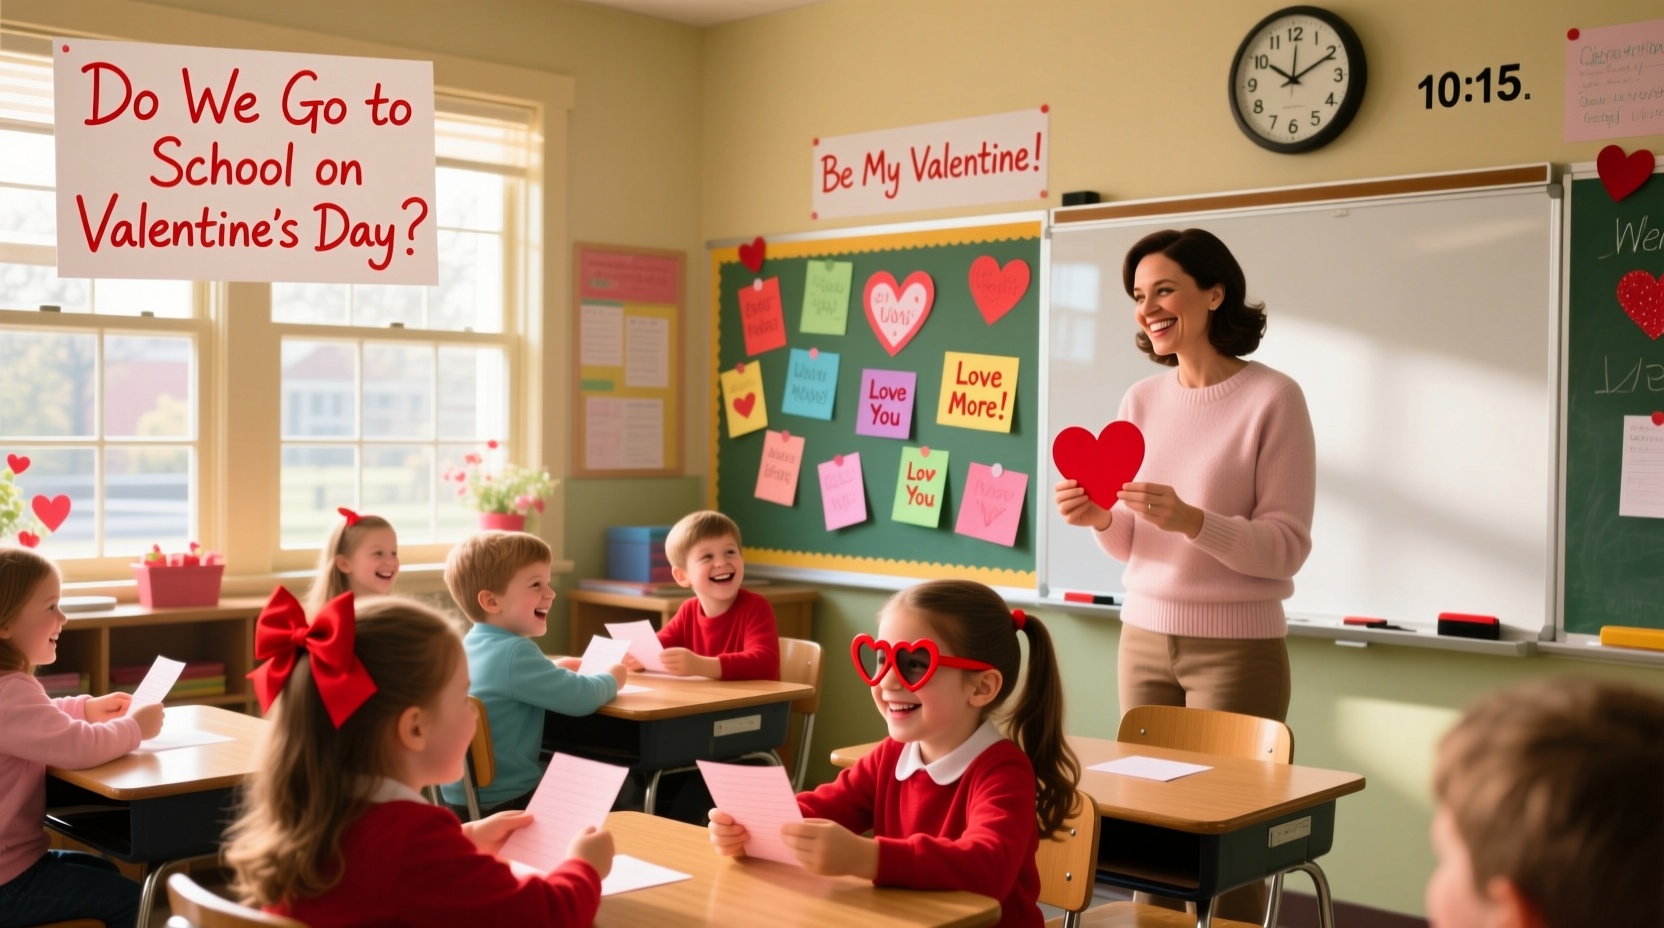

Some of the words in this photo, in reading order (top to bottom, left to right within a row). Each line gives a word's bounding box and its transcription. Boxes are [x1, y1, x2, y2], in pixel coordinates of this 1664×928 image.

[1288, 26, 1304, 42] 12
[1314, 30, 1318, 46] 1
[1269, 35, 1280, 50] 11
[1325, 45, 1337, 61] 2
[1254, 54, 1269, 70] 10
[1333, 67, 1344, 83] 3
[1247, 77, 1258, 93] 9
[81, 61, 159, 126] Do
[182, 67, 260, 125] We
[281, 69, 348, 134] Go
[365, 82, 413, 127] to
[1324, 91, 1339, 107] 4
[1253, 99, 1264, 114] 8
[1268, 114, 1278, 130] 7
[1288, 118, 1299, 134] 6
[1310, 110, 1321, 126] 5
[149, 135, 294, 188] School
[315, 159, 363, 186] on
[820, 154, 854, 193] Be
[862, 149, 901, 199] My
[910, 131, 1042, 182] Valentine!
[76, 192, 299, 253] Valentine's
[313, 196, 429, 271] Day?
[955, 361, 1003, 389] Love
[869, 378, 907, 402] Love
[947, 391, 1008, 421] More!
[869, 403, 901, 427] You
[906, 461, 936, 482] Lov
[905, 485, 935, 508] You
